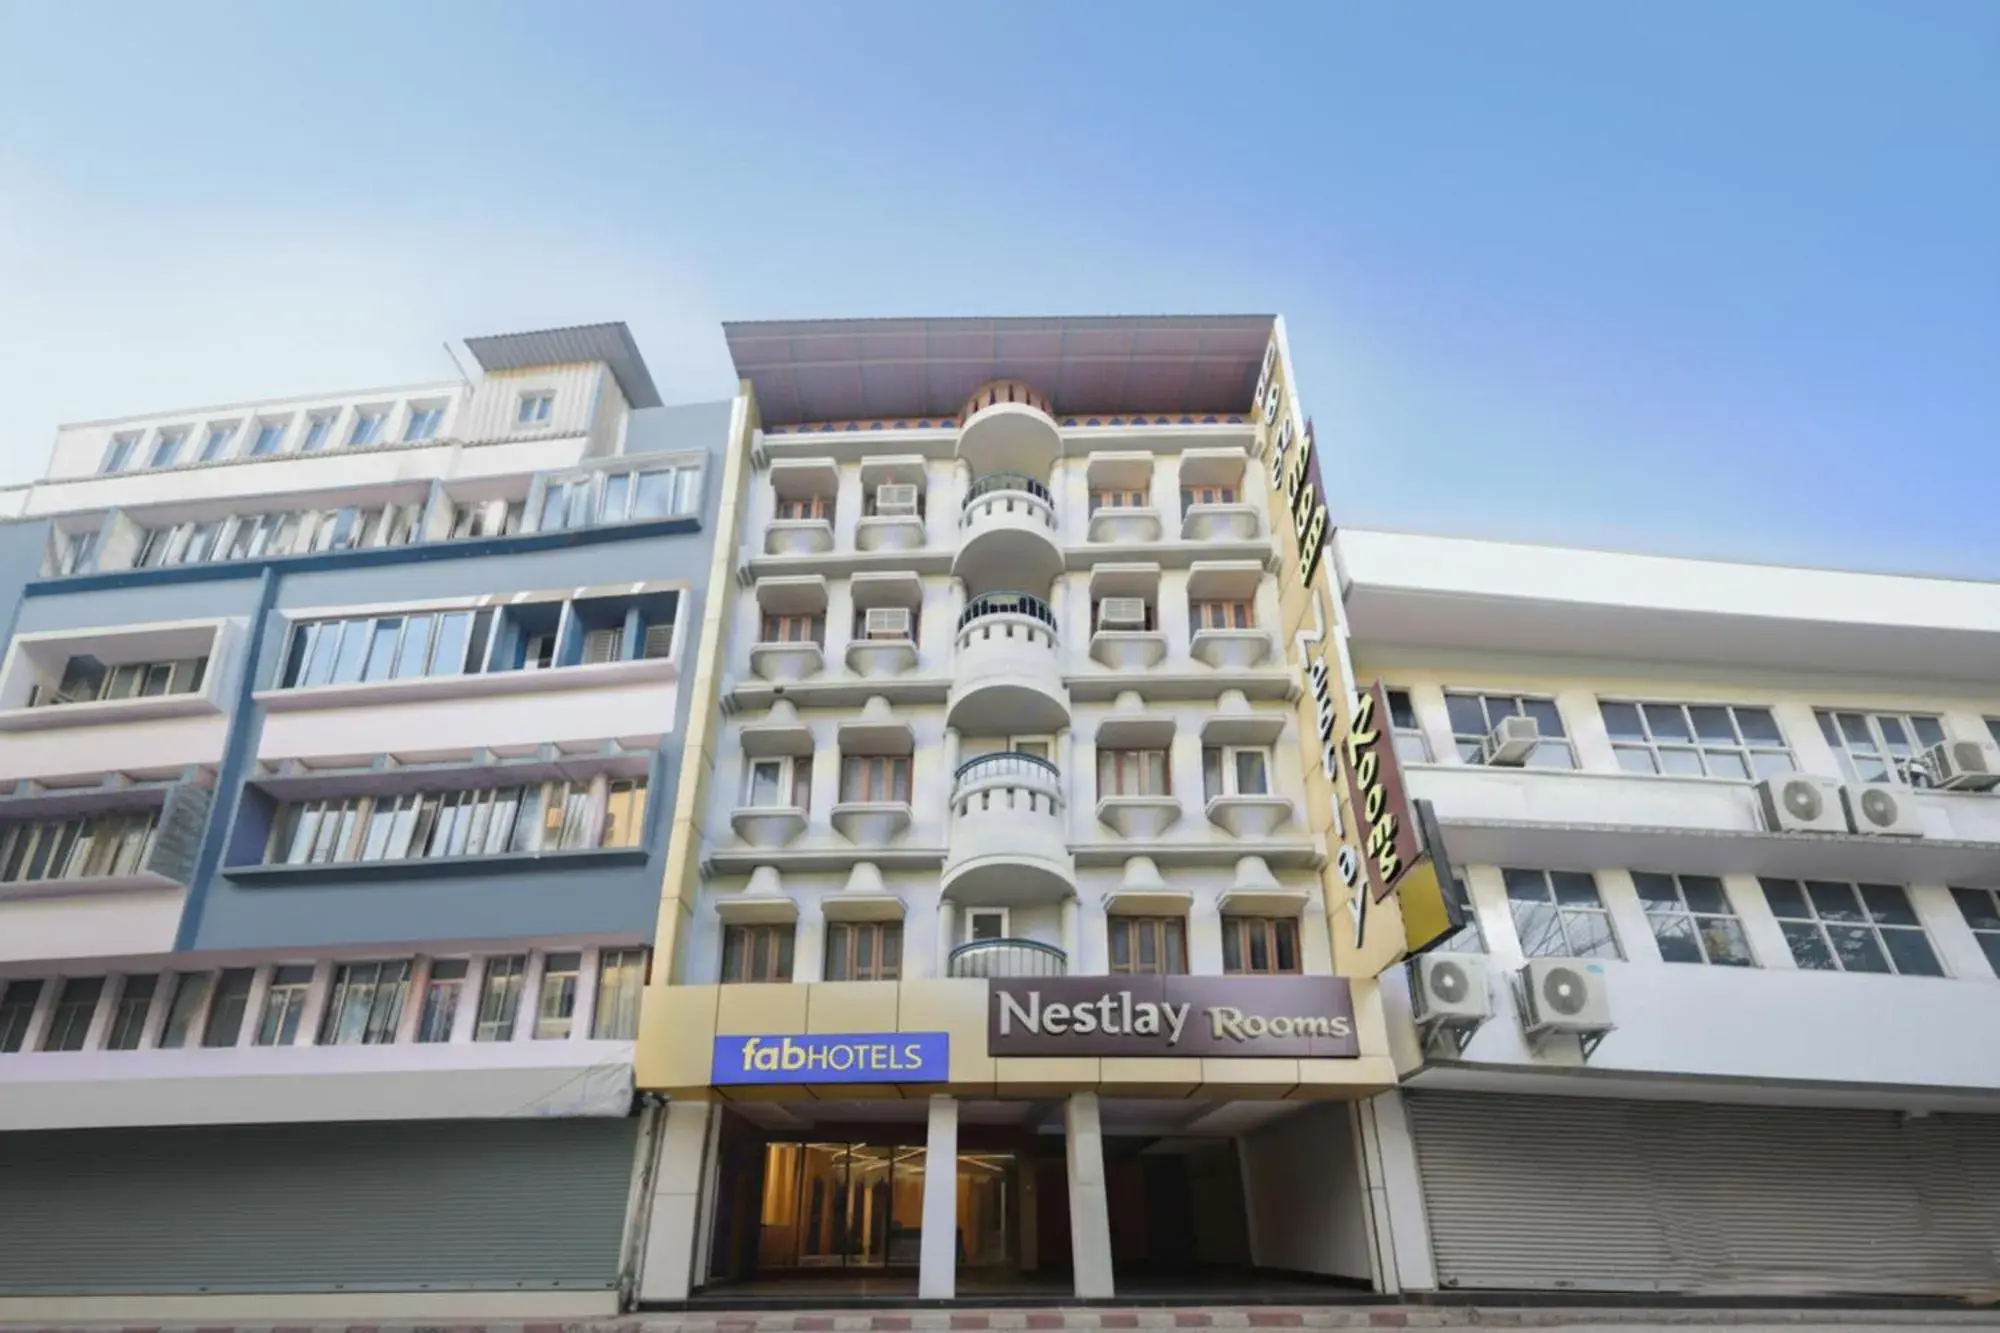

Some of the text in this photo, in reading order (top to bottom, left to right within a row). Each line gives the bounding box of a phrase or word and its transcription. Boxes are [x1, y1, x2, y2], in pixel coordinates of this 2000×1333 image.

[996, 989, 1351, 1046] Nestlay Rooms
[742, 1037, 922, 1072] fabHOTELS
